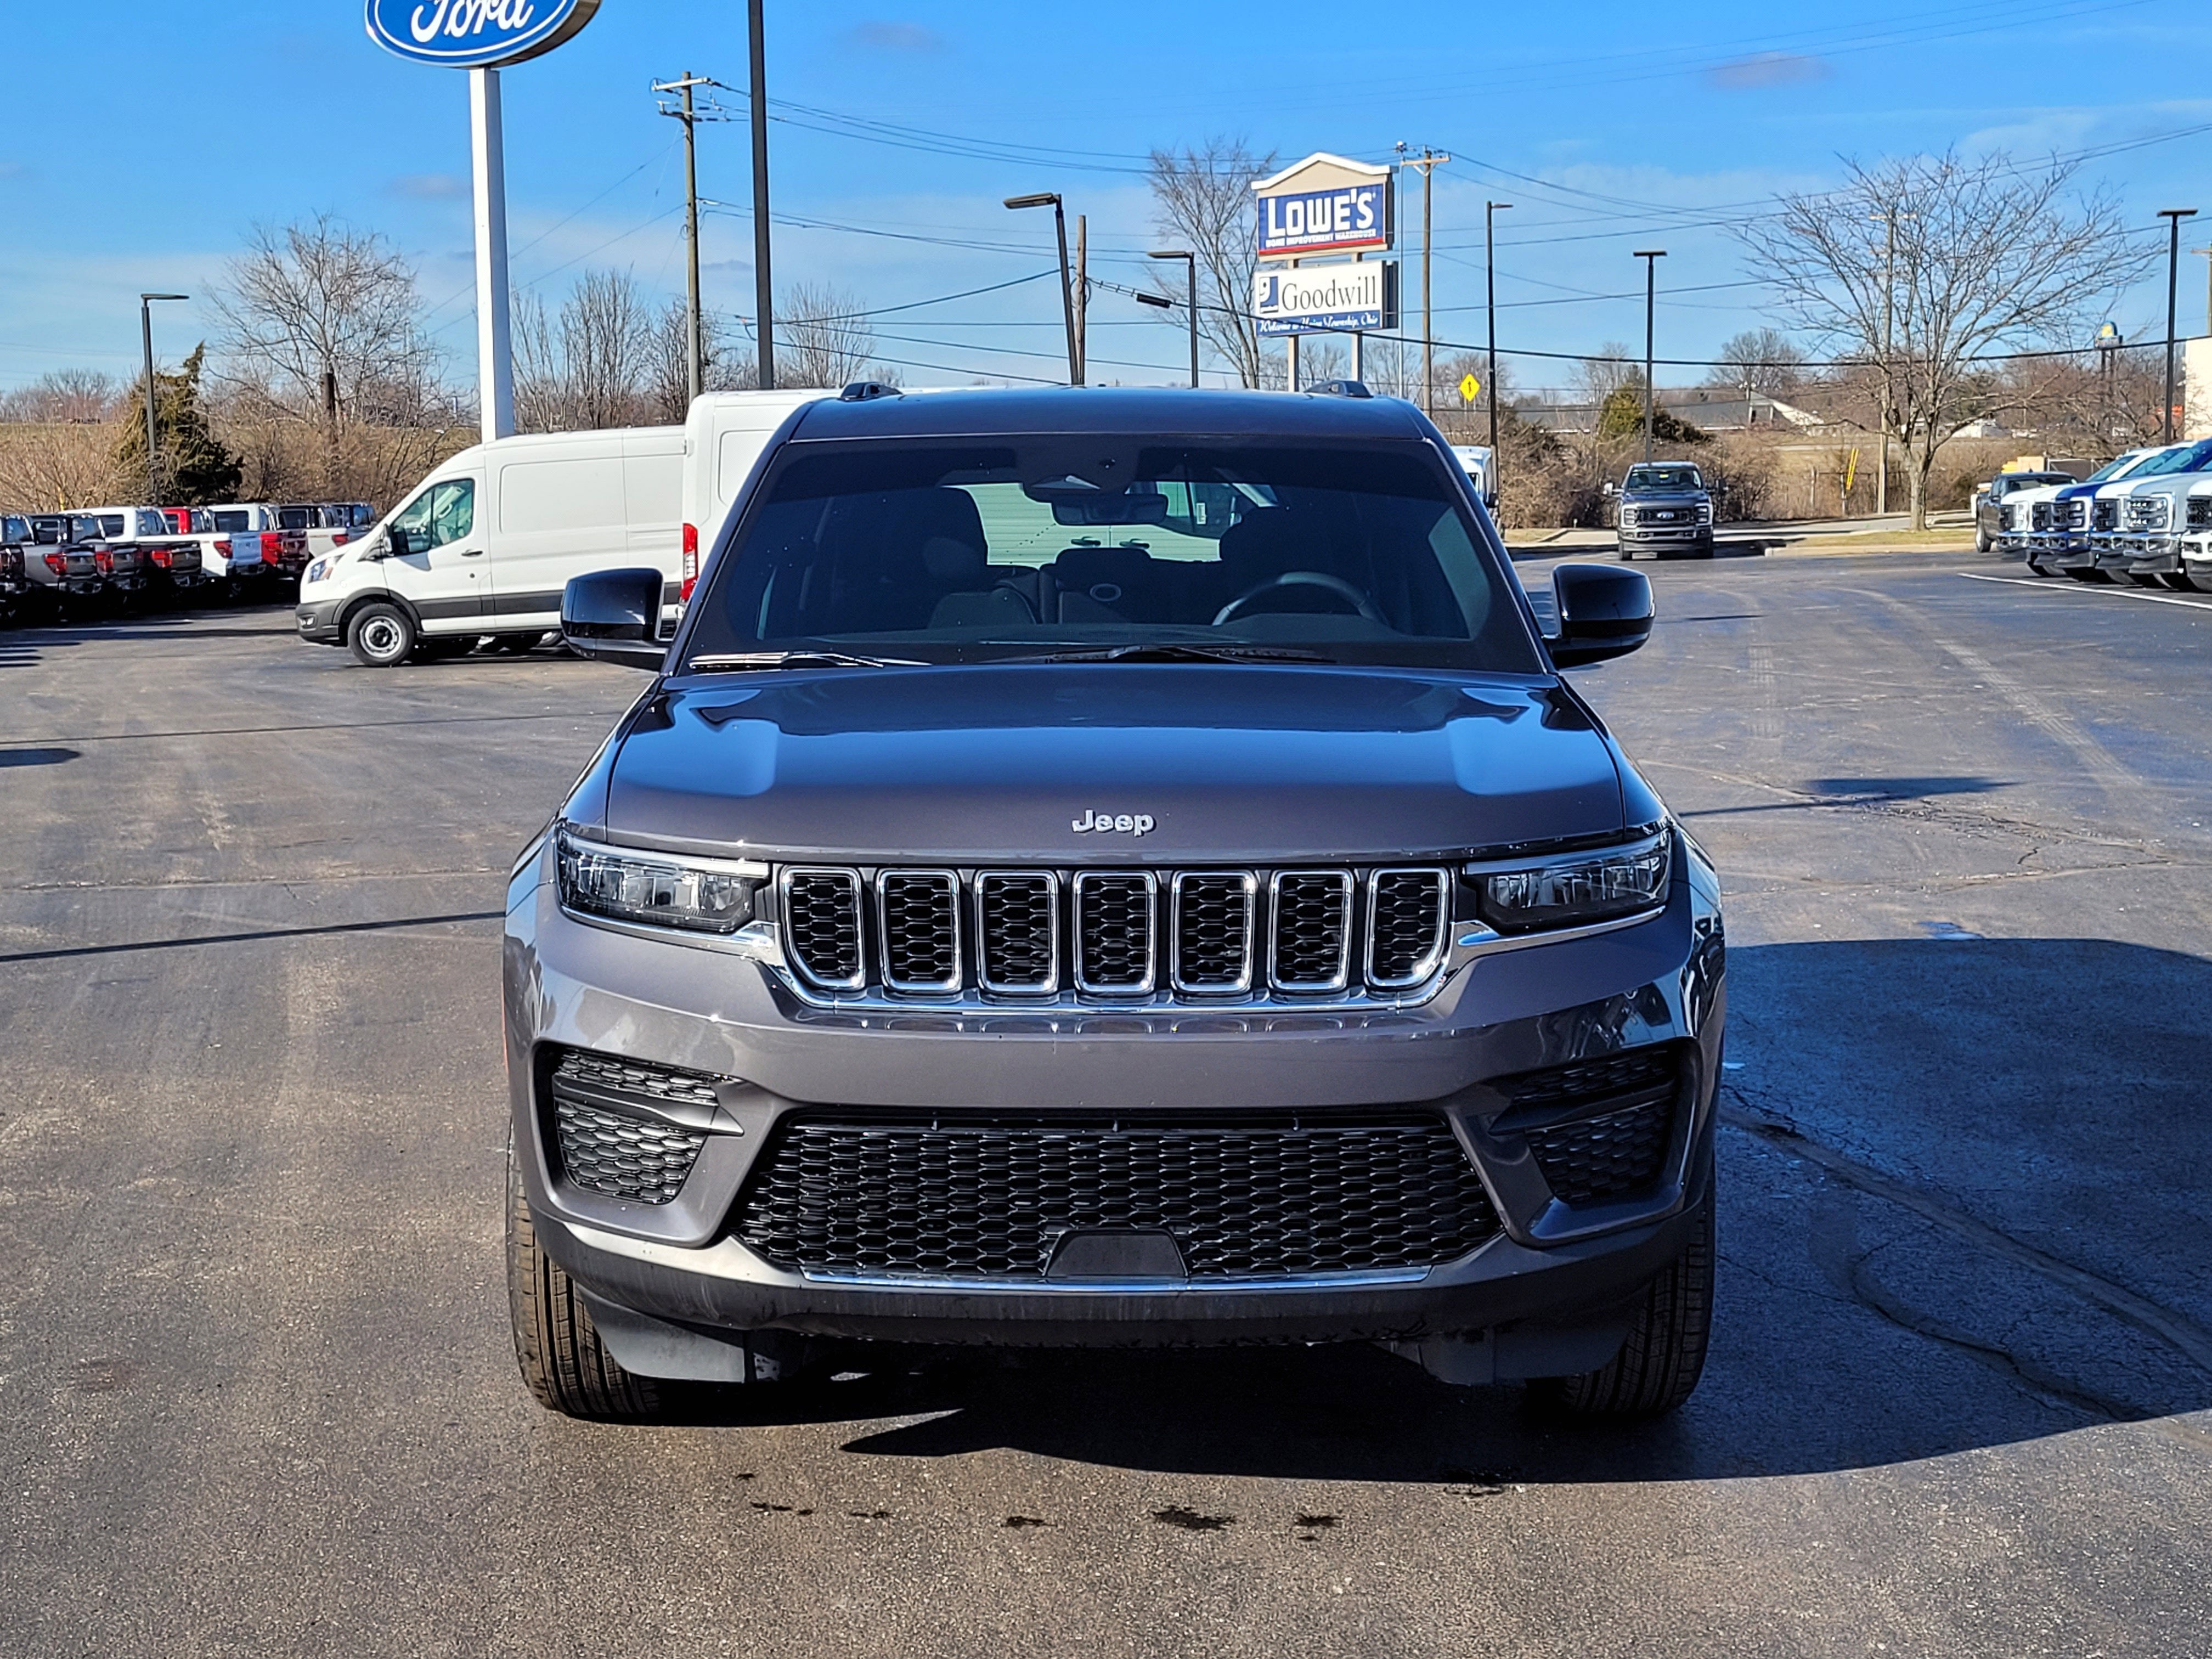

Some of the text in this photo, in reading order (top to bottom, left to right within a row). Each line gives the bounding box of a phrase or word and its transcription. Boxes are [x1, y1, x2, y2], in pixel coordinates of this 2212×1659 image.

[411, 0, 534, 42] Ford
[1267, 188, 1374, 238] LOWE'S
[1282, 275, 1376, 311] Goodwill
[1071, 809, 1154, 837] Jeep
